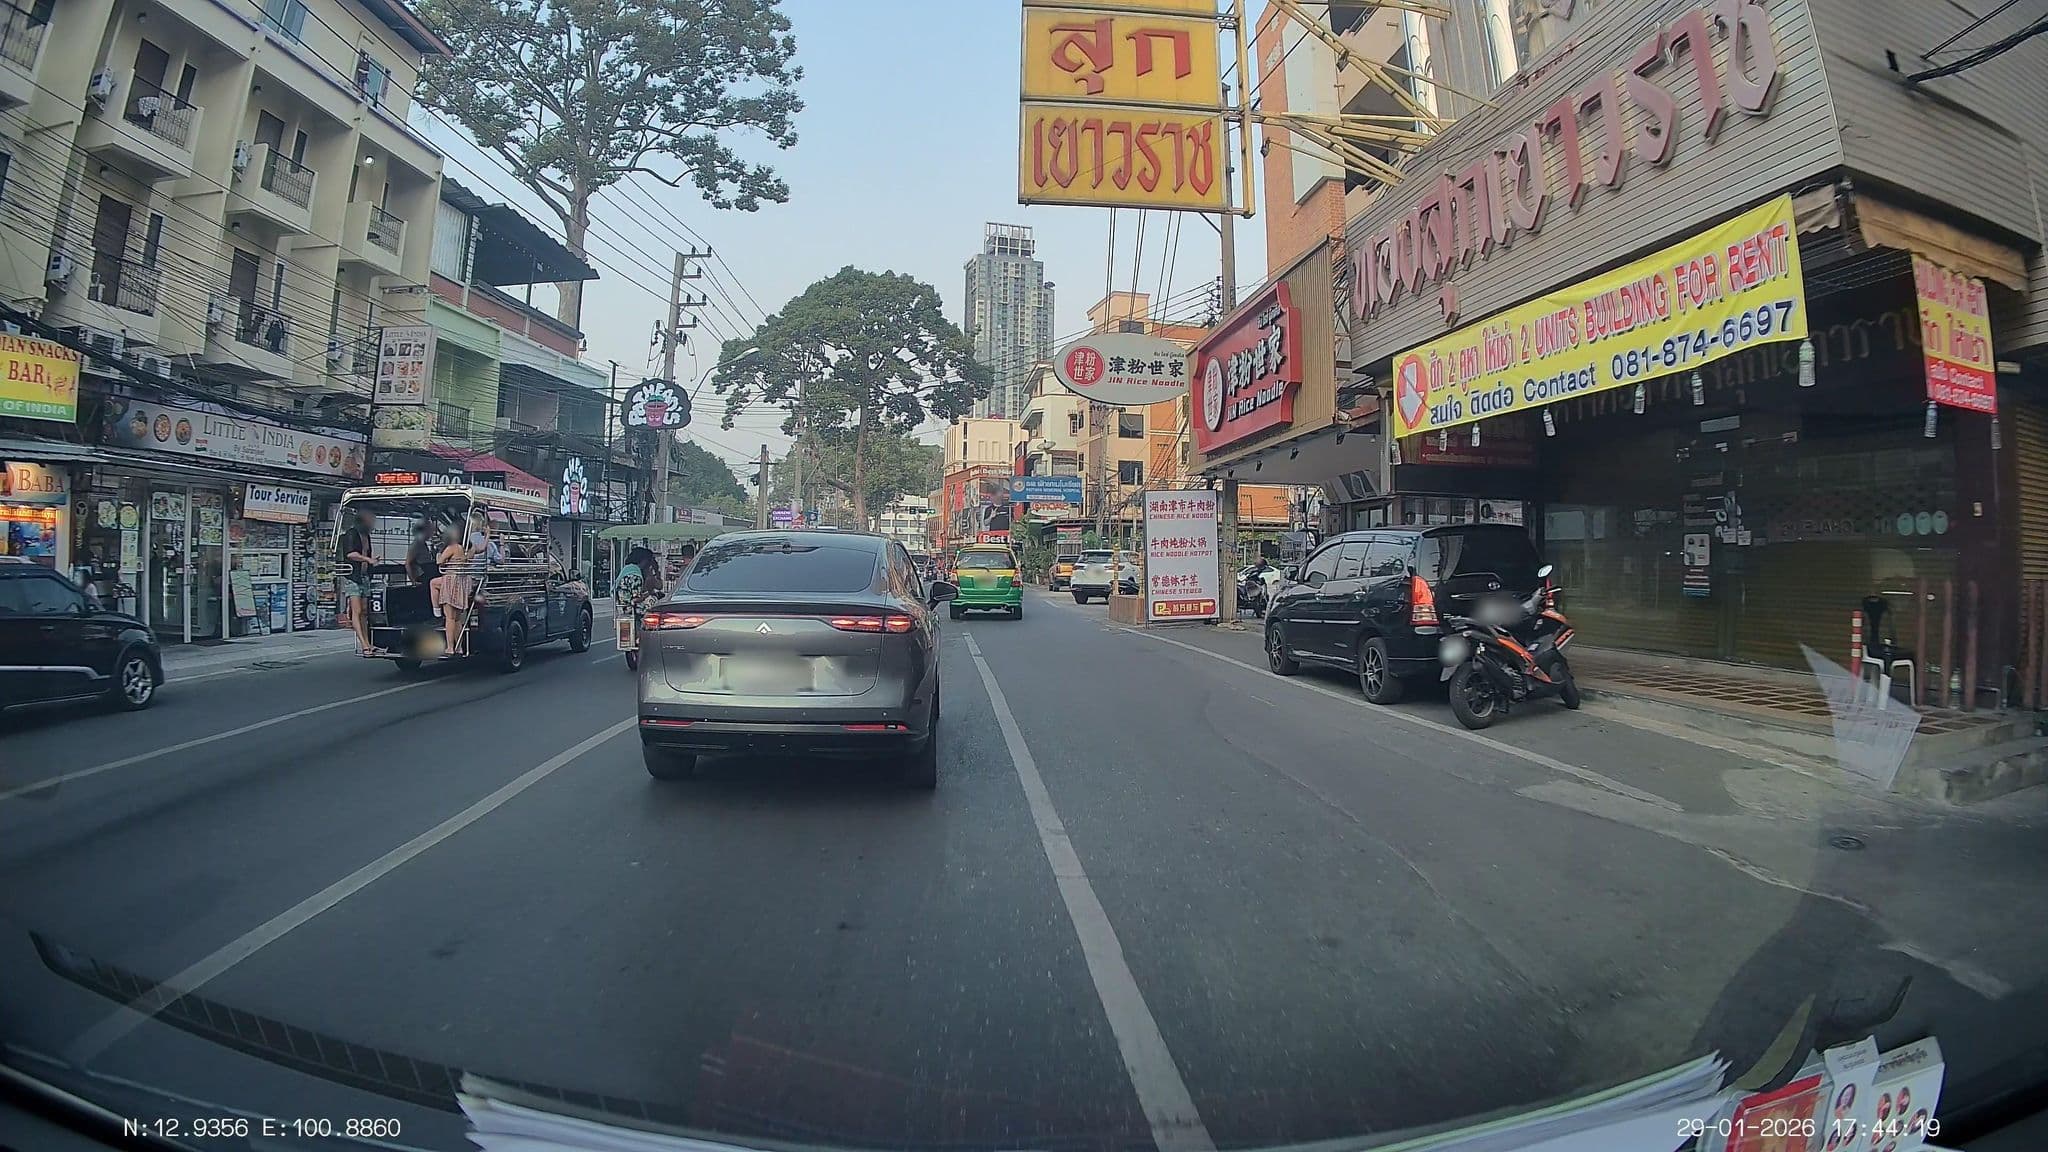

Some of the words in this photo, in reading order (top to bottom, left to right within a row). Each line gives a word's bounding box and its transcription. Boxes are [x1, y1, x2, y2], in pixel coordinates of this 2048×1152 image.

[1050, 18, 1192, 95] สุก
[1032, 116, 1214, 196] เยาวราช
[1448, 351, 1456, 388] 2
[1520, 325, 1530, 363] 2
[1534, 307, 1581, 358] UNITS
[1584, 273, 1671, 344] BUILDING
[1675, 255, 1722, 314] FOR
[1727, 223, 1790, 293] RENT
[29, 341, 78, 362] SNACKS
[1227, 324, 1284, 397] 津粉世家
[1430, 394, 1463, 426] สนใจ
[1470, 381, 1515, 416] ติดต่อ
[1523, 363, 1597, 402] Contact
[1611, 299, 1795, 381] 081-874-6697
[8, 360, 44, 384] BAR
[1108, 356, 1185, 378] 津粉世家
[1107, 376, 1122, 384] JIN
[1126, 377, 1148, 386] Rice
[1151, 378, 1185, 388] Noodle
[3, 400, 25, 411] OF
[26, 401, 67, 415] INDIA
[1227, 401, 1238, 422] JIN
[1239, 396, 1255, 415] Rice
[1256, 381, 1285, 408] Noodle
[203, 416, 246, 440] LITTLE
[262, 426, 294, 448] INDIA
[18, 468, 65, 493] BABA
[250, 485, 272, 501] Tour
[274, 487, 309, 506] Service
[372, 600, 382, 612] 8
